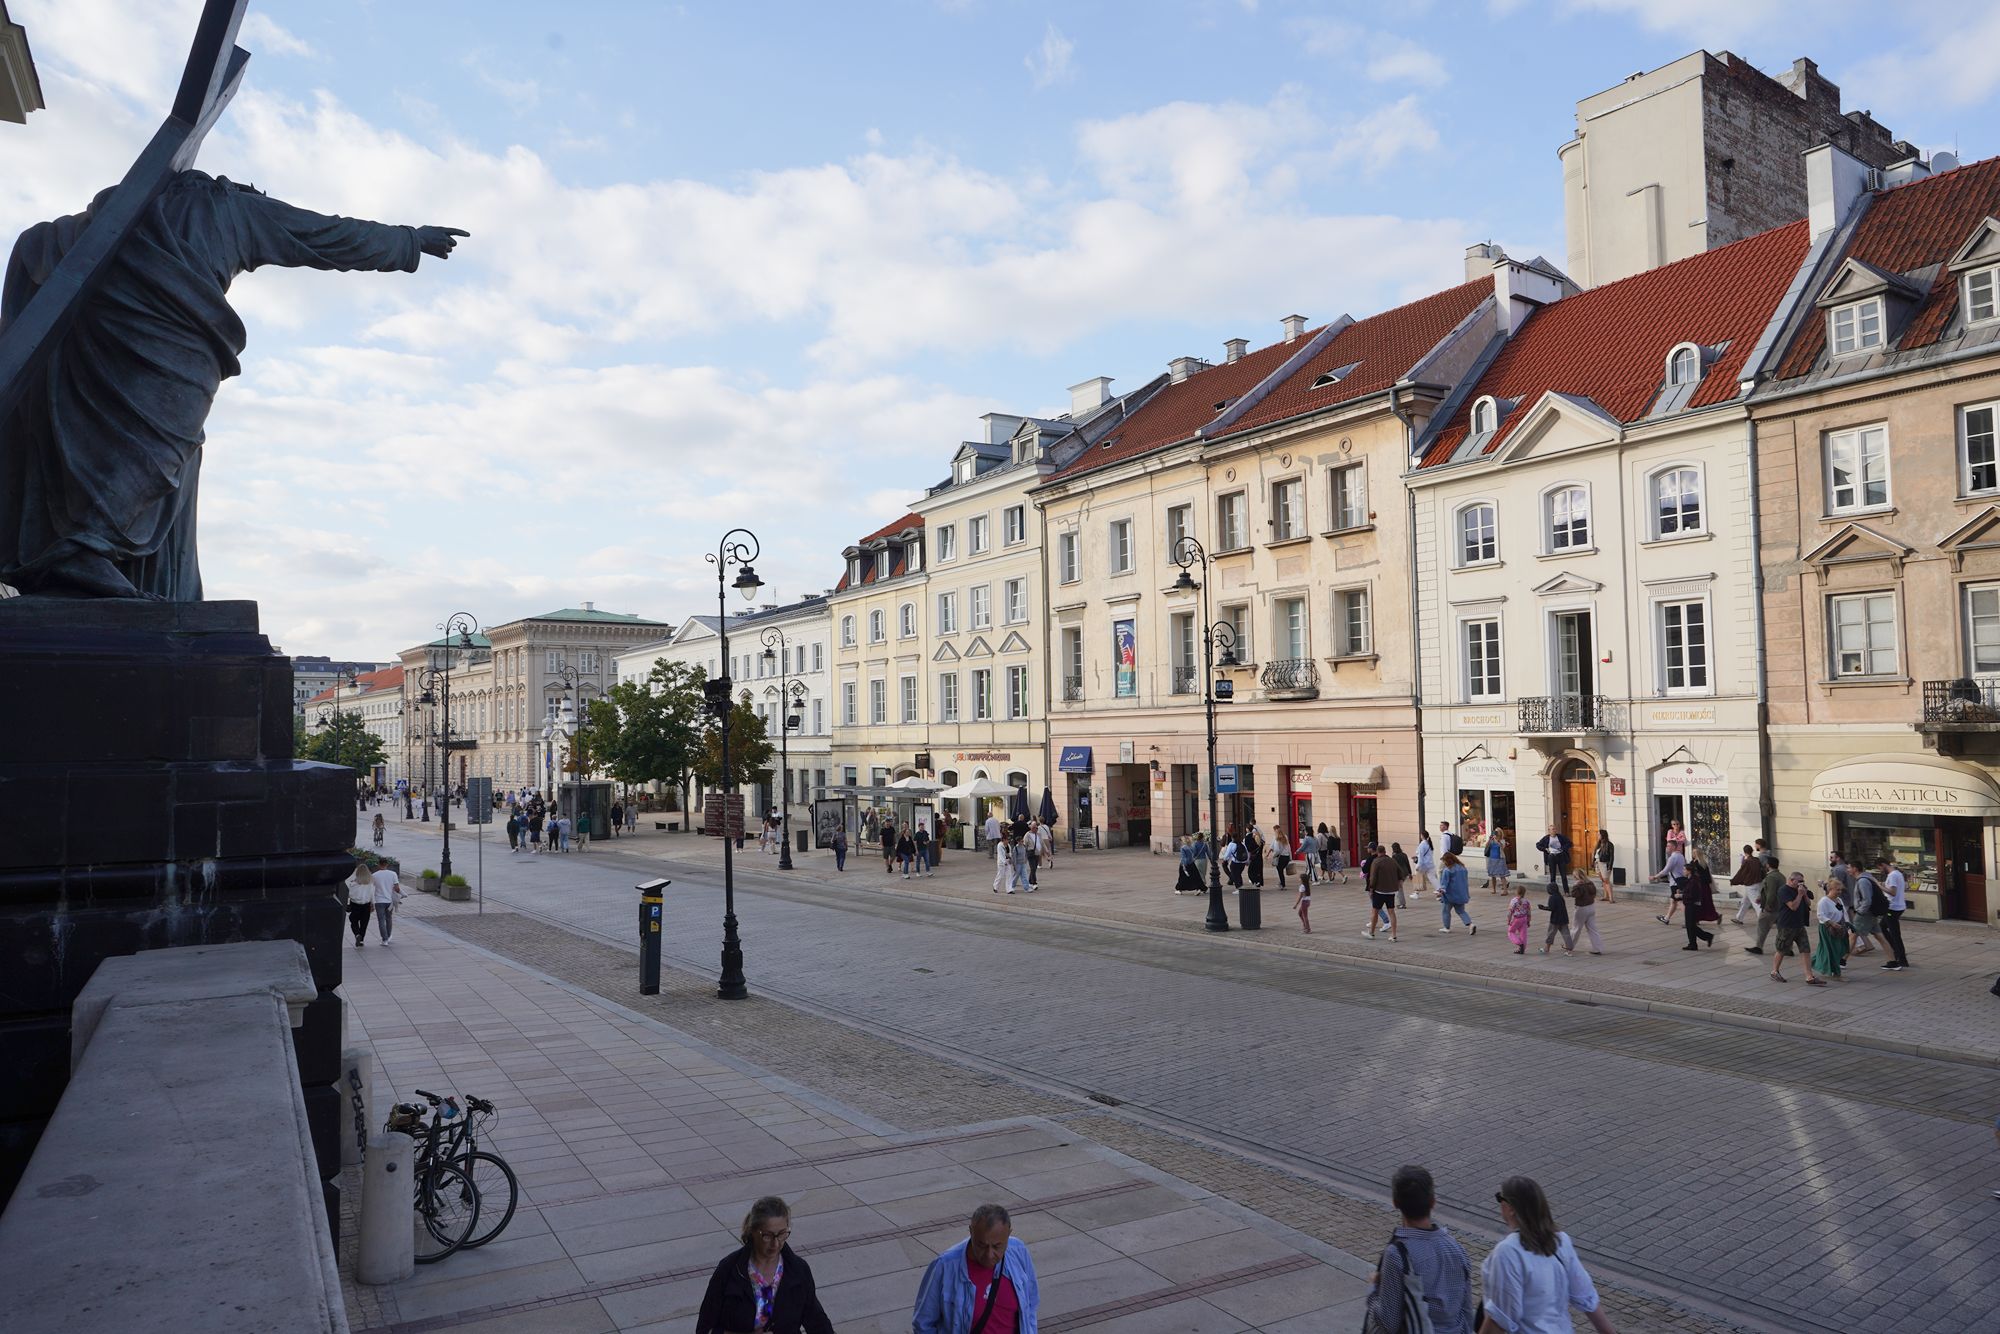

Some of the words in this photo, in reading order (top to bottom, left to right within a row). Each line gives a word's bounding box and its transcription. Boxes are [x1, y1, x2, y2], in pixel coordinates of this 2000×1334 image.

[1662, 776, 1685, 785] INDIA
[1686, 777, 1719, 785] MARKET
[1821, 787, 1882, 800] GALERIA
[1888, 789, 1958, 802] ATTICUS
